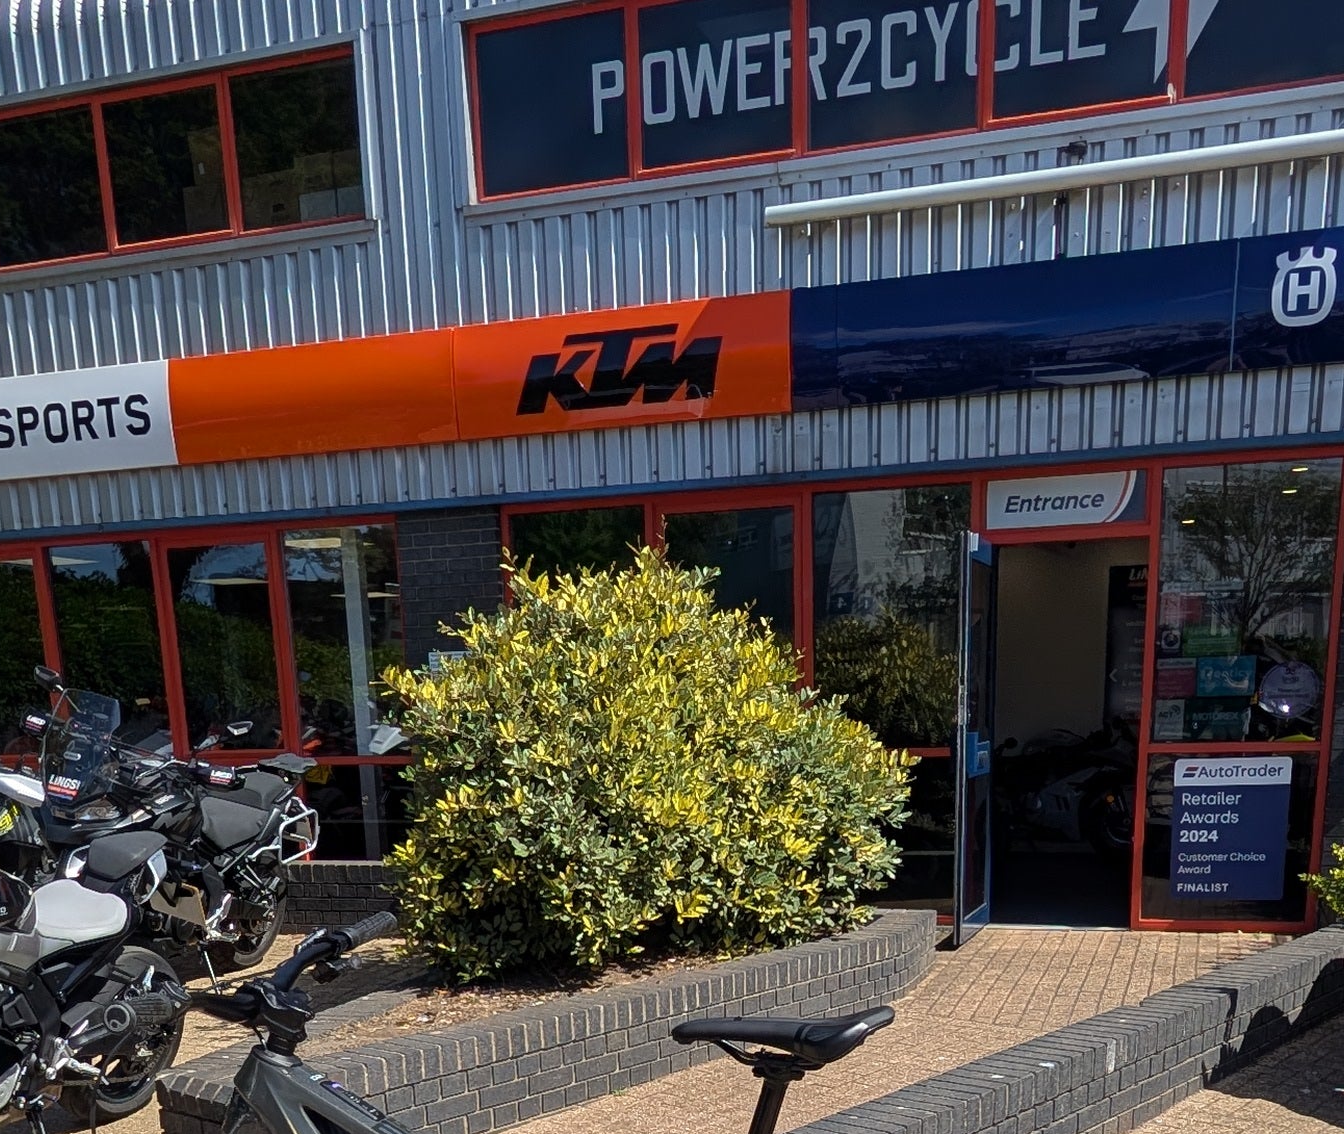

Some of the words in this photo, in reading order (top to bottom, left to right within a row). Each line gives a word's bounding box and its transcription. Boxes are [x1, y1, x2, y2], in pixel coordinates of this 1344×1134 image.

[590, 0, 1107, 135] POWER2CYCLE
[516, 322, 722, 415] KTM
[1003, 490, 1105, 514] Entrance
[1197, 763, 1285, 778] AutoTrader
[1181, 791, 1242, 806] Retailer
[1179, 810, 1240, 824] Awards
[1179, 829, 1219, 843] 2024
[1177, 852, 1228, 862] Customer
[1229, 851, 1266, 862] Choice
[1177, 865, 1212, 874] Award
[1176, 882, 1229, 893] FINALIST
